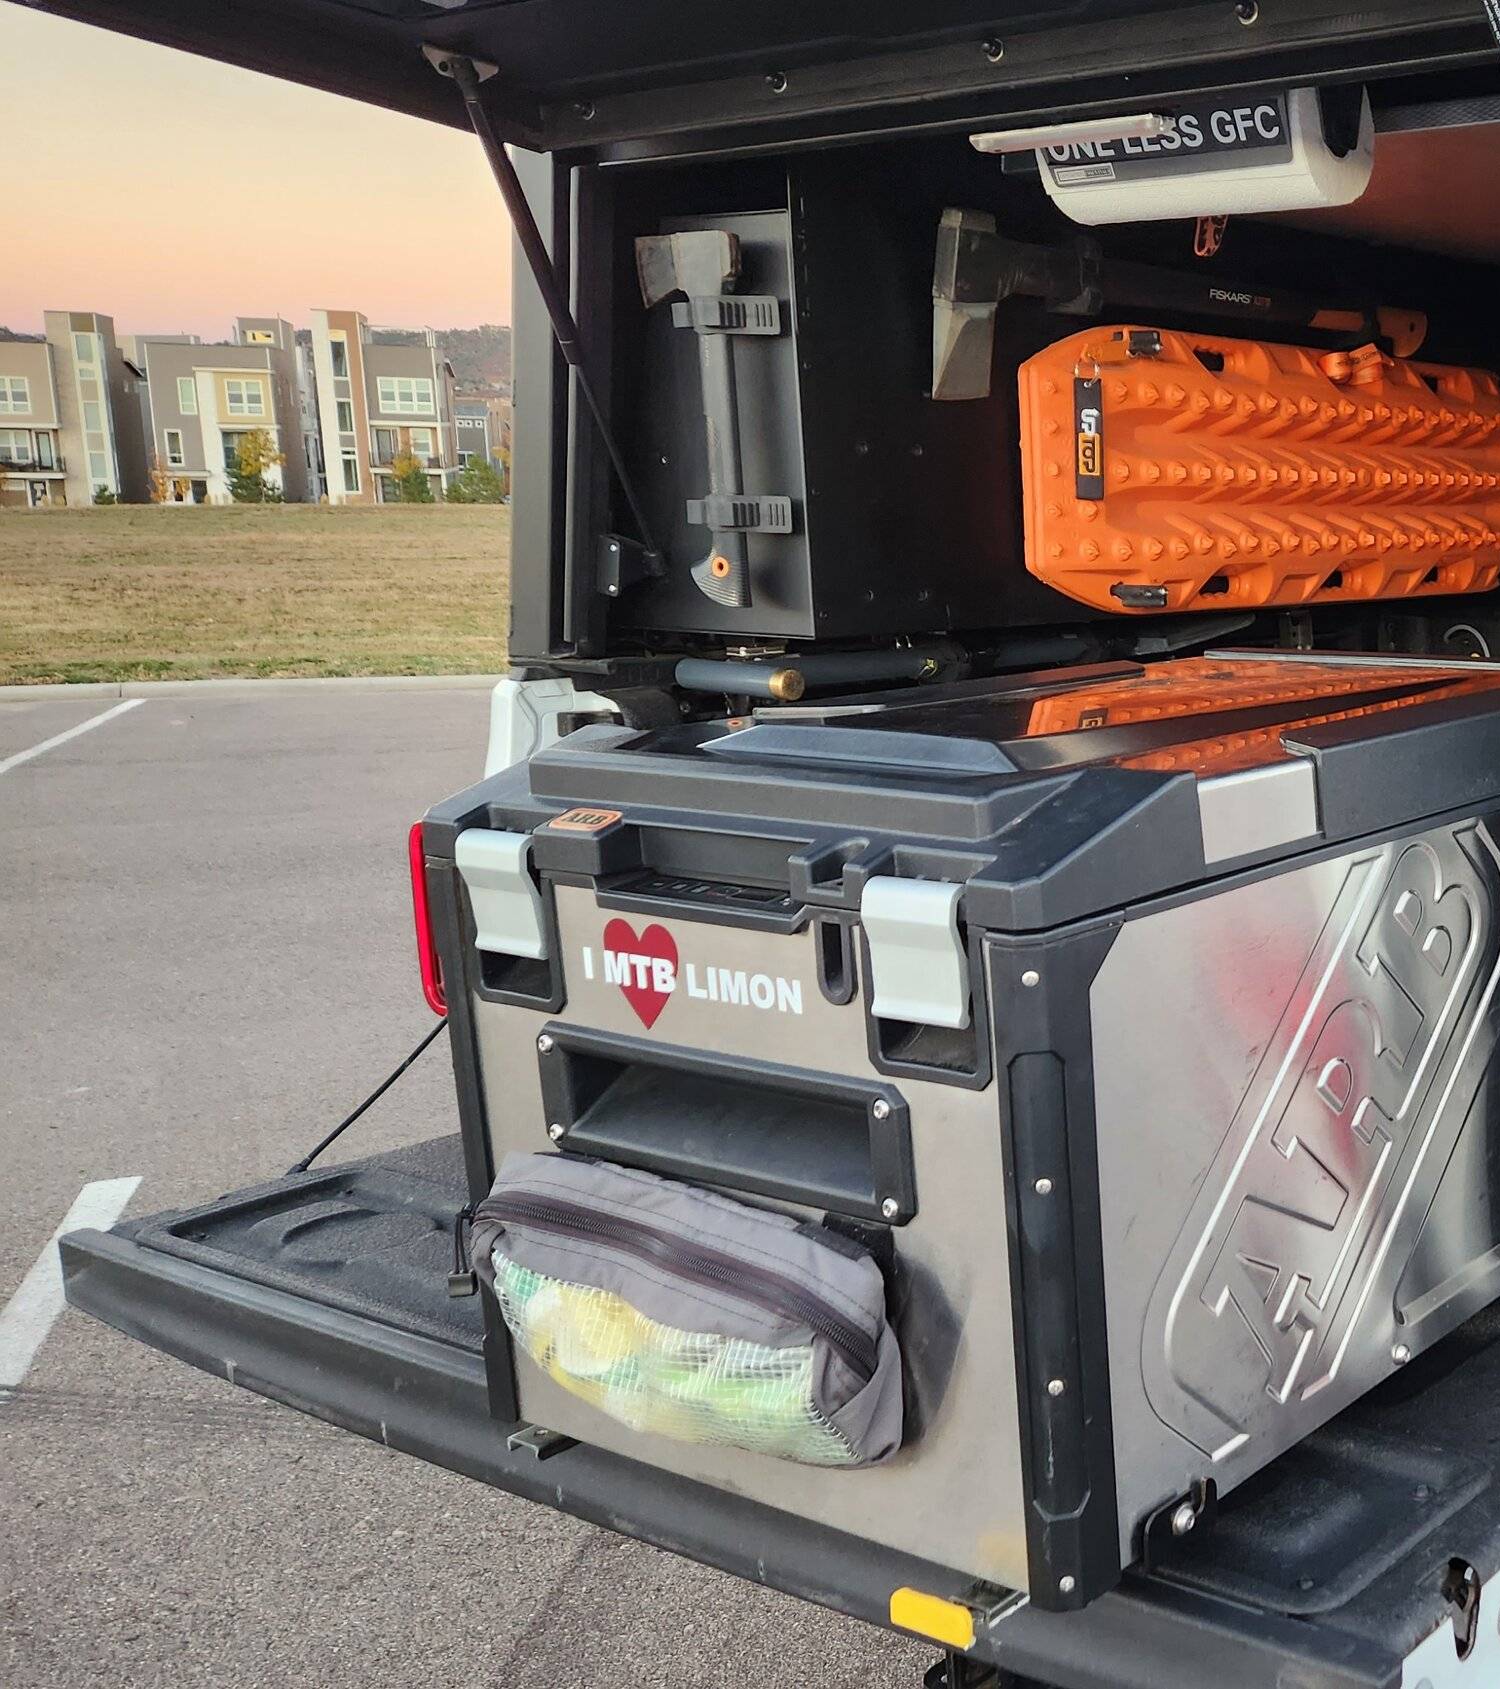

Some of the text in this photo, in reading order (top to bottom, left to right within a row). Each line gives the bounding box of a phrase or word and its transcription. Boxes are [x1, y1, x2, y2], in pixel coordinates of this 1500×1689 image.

[1123, 115, 1204, 154] LESS
[1210, 105, 1280, 144] GFC
[1209, 288, 1252, 304] FISKARS
[582, 947, 803, 1014] I MTB LIMON
[1200, 838, 1487, 1403] ARB
